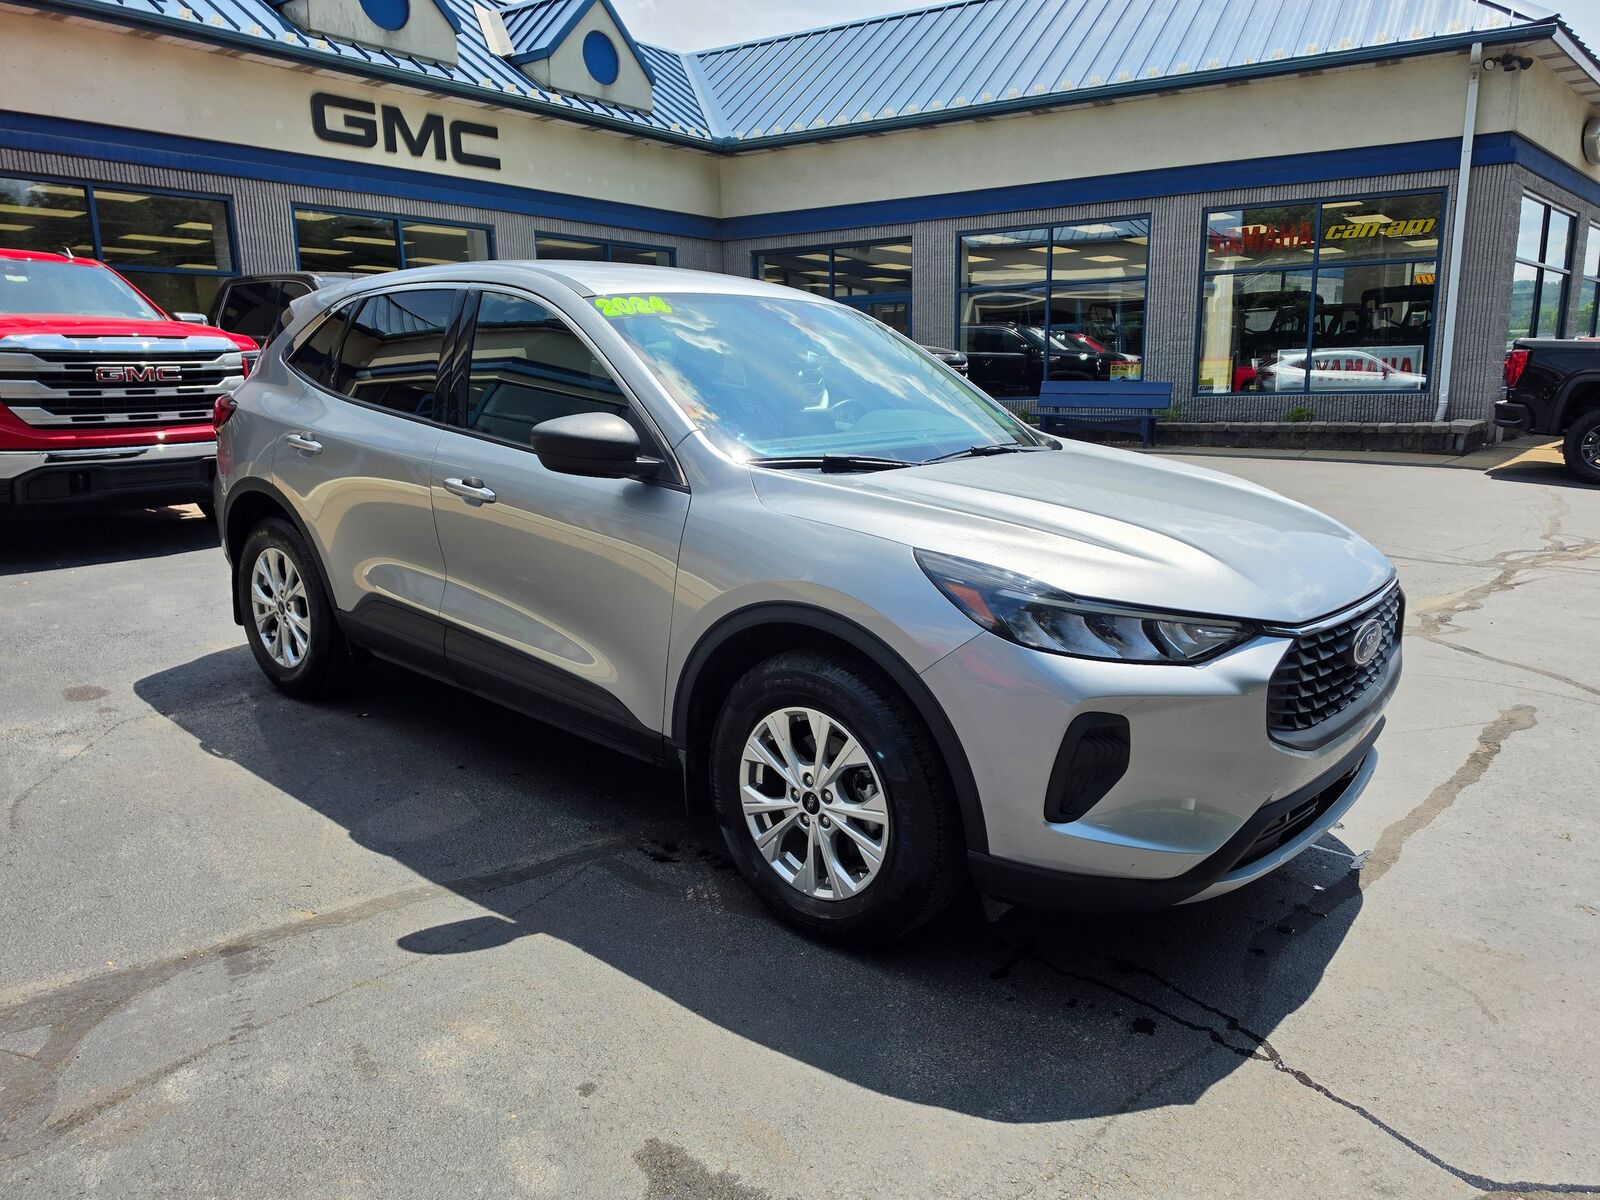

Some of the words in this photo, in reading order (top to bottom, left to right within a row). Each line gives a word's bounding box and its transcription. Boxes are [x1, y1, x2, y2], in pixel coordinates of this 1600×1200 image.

[310, 92, 501, 170] GMC
[1325, 217, 1436, 240] can-am
[595, 296, 673, 317] 2024
[95, 366, 182, 382] GMC
